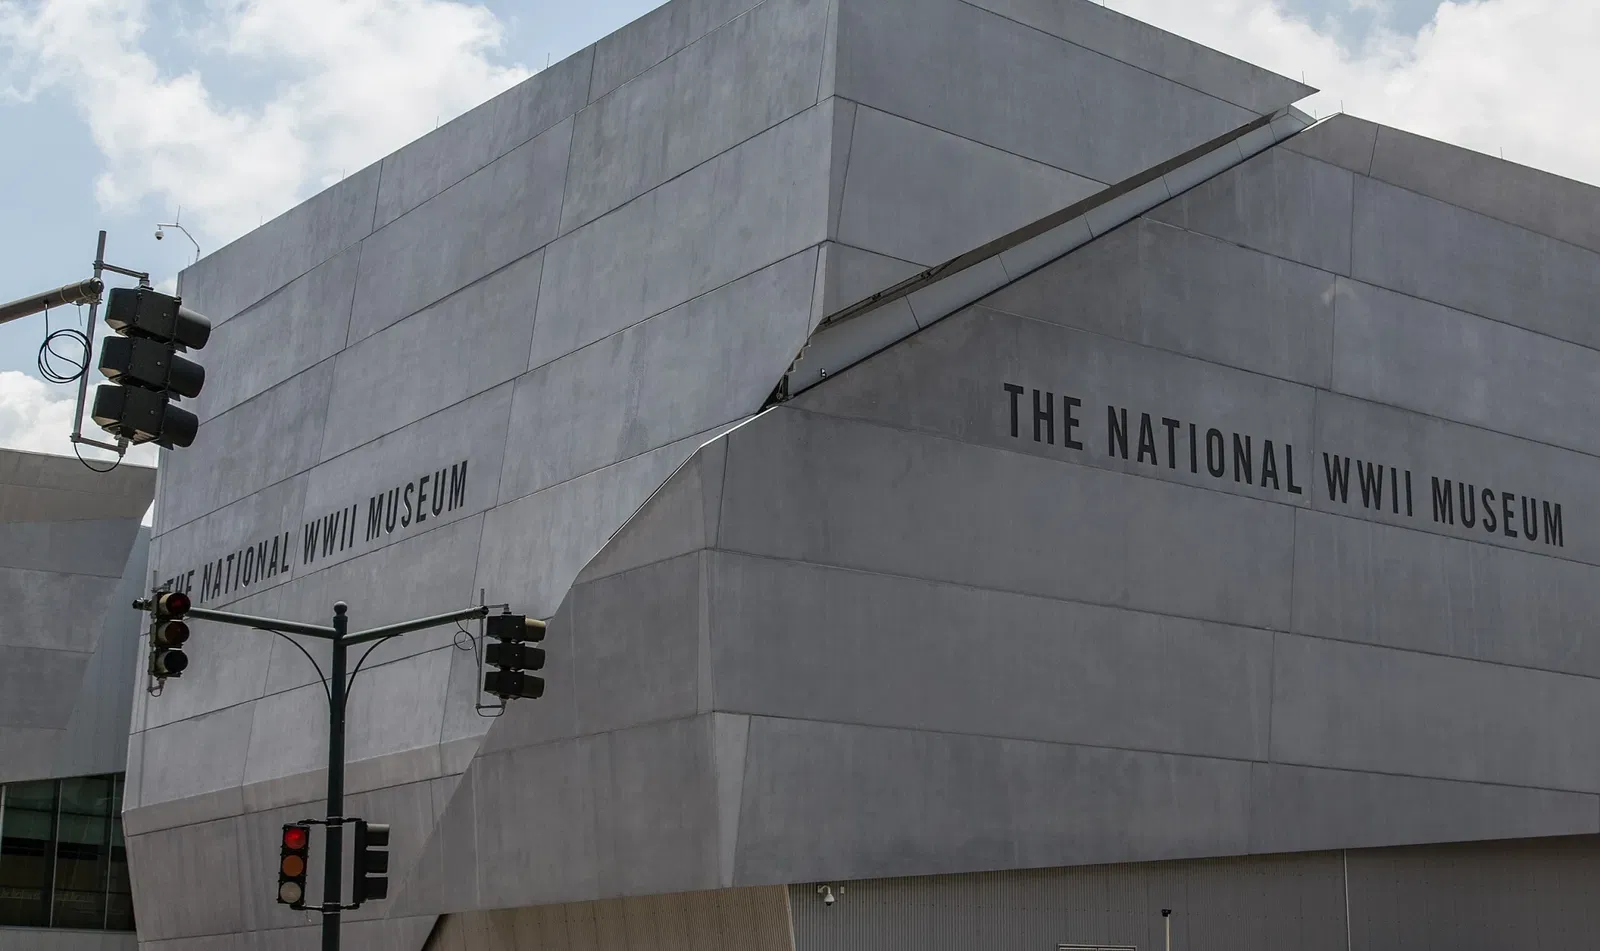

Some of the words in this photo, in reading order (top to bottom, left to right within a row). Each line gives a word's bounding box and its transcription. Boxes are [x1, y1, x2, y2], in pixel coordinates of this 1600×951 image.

[200, 531, 289, 603] NATIONAL
[303, 503, 358, 565] WWII
[365, 459, 468, 542] MUSEUM
[1003, 382, 1084, 451] THE
[1107, 404, 1303, 495] NATIONAL
[1322, 451, 1413, 517] WWII
[1431, 475, 1564, 548] MUSEUM
